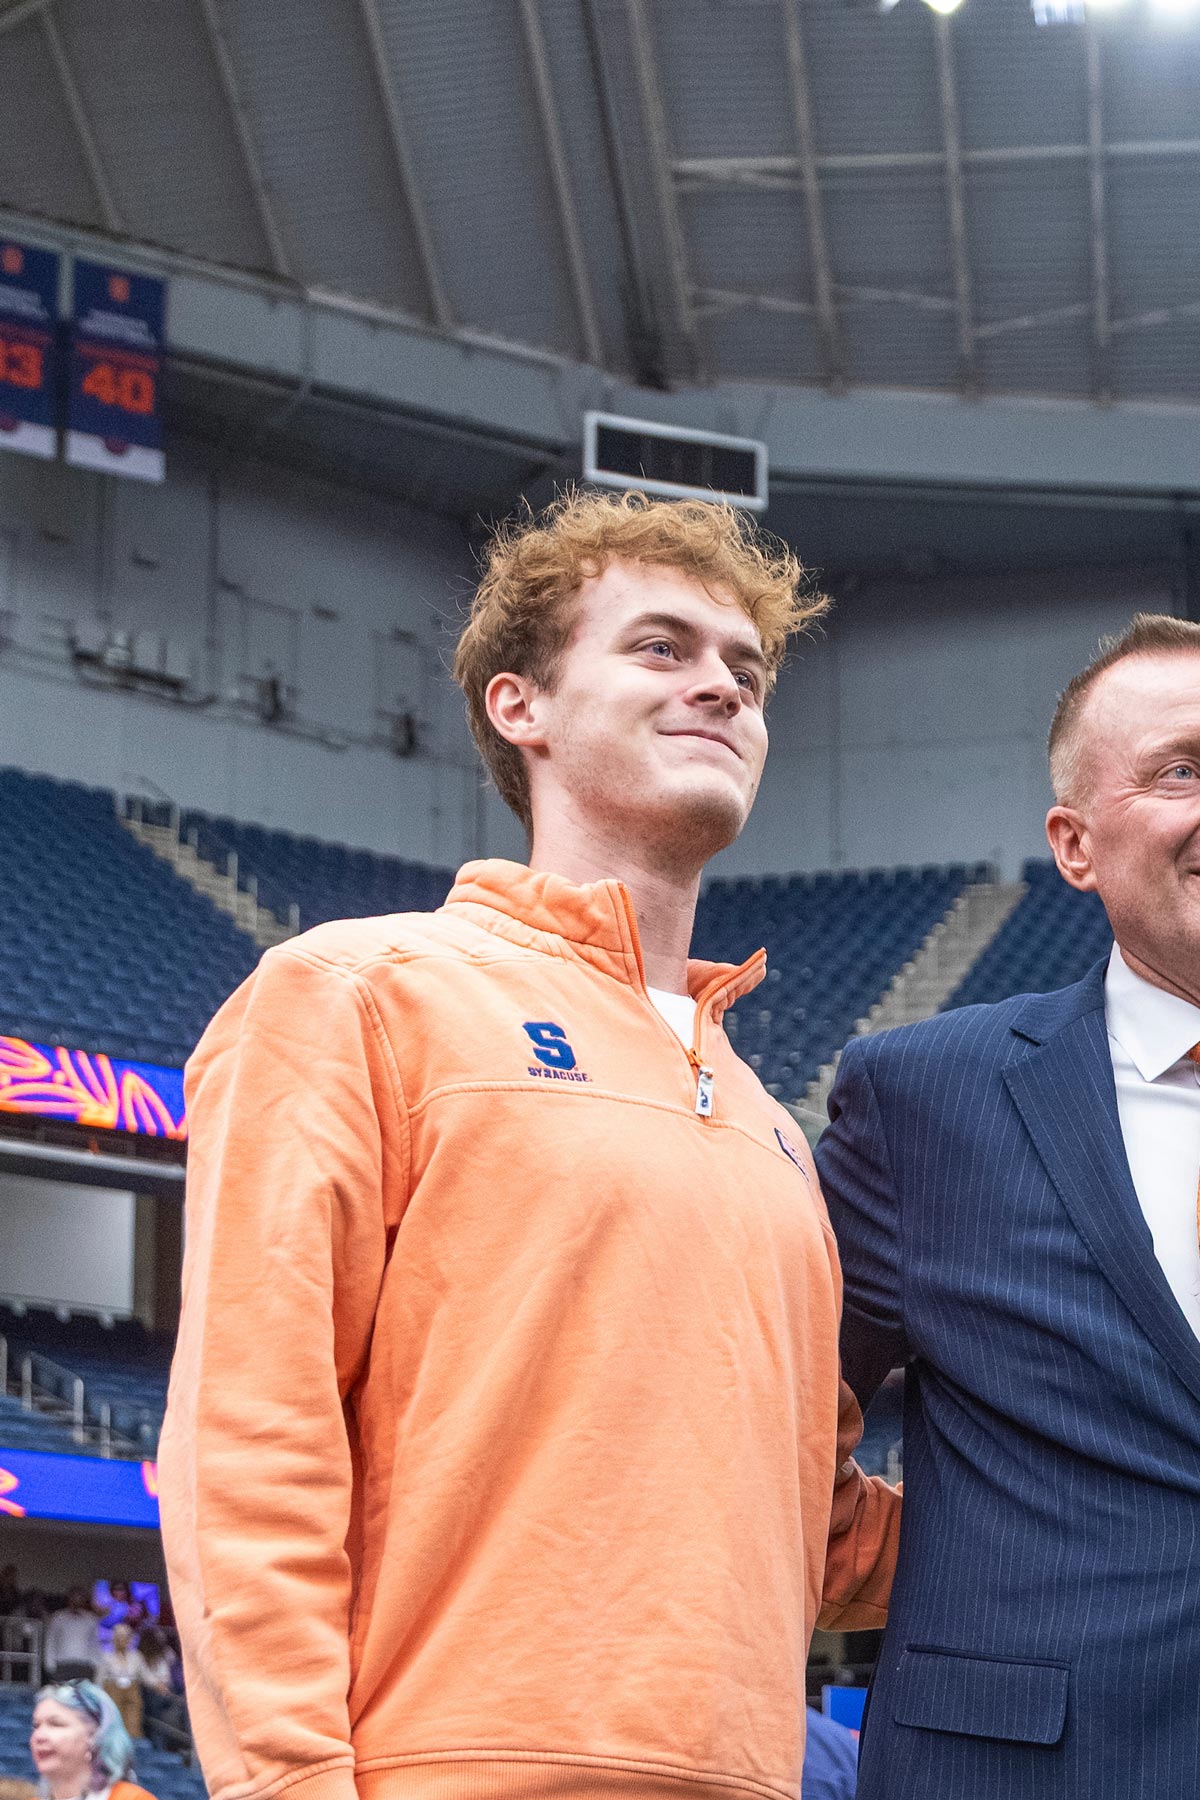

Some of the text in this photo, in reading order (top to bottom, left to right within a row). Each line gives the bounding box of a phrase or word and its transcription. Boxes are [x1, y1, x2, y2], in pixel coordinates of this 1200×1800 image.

[82, 362, 154, 414] 40
[522, 1022, 576, 1071] S
[528, 1066, 590, 1082] SYRACUSE
